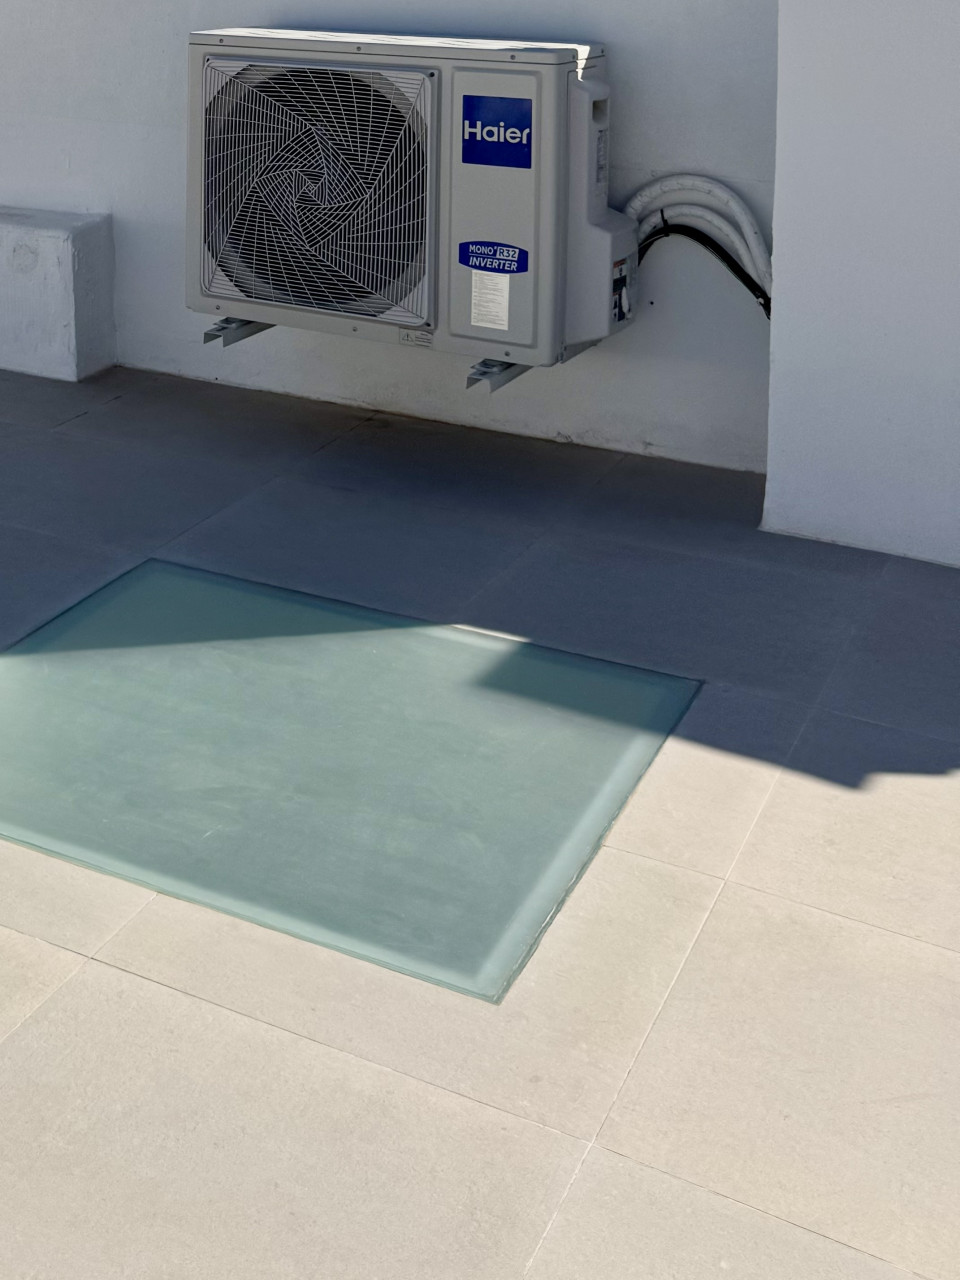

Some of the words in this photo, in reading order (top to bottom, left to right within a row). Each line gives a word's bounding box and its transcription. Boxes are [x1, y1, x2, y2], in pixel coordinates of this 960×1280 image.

[464, 120, 530, 144] Haier
[498, 248, 517, 259] R32
[469, 256, 518, 271] INVERTER
